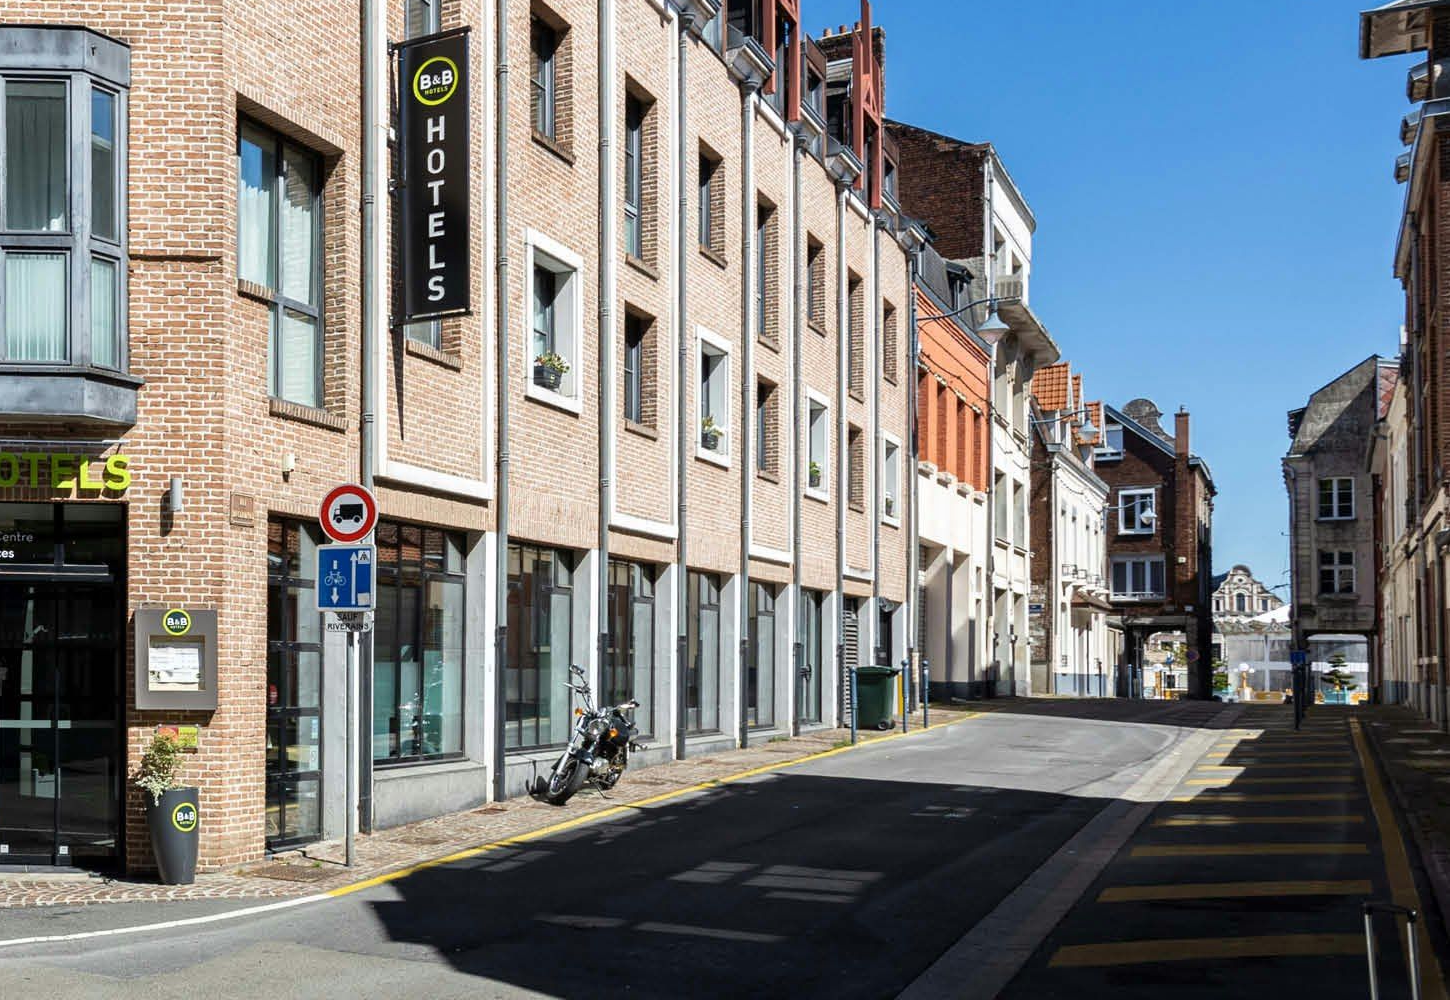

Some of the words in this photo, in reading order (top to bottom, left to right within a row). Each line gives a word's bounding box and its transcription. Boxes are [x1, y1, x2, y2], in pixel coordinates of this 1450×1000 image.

[420, 69, 453, 90] B&B
[424, 85, 449, 96] HOTELS
[427, 115, 446, 301] HOTELS
[167, 617, 188, 626] B&B
[337, 612, 358, 621] SAUF
